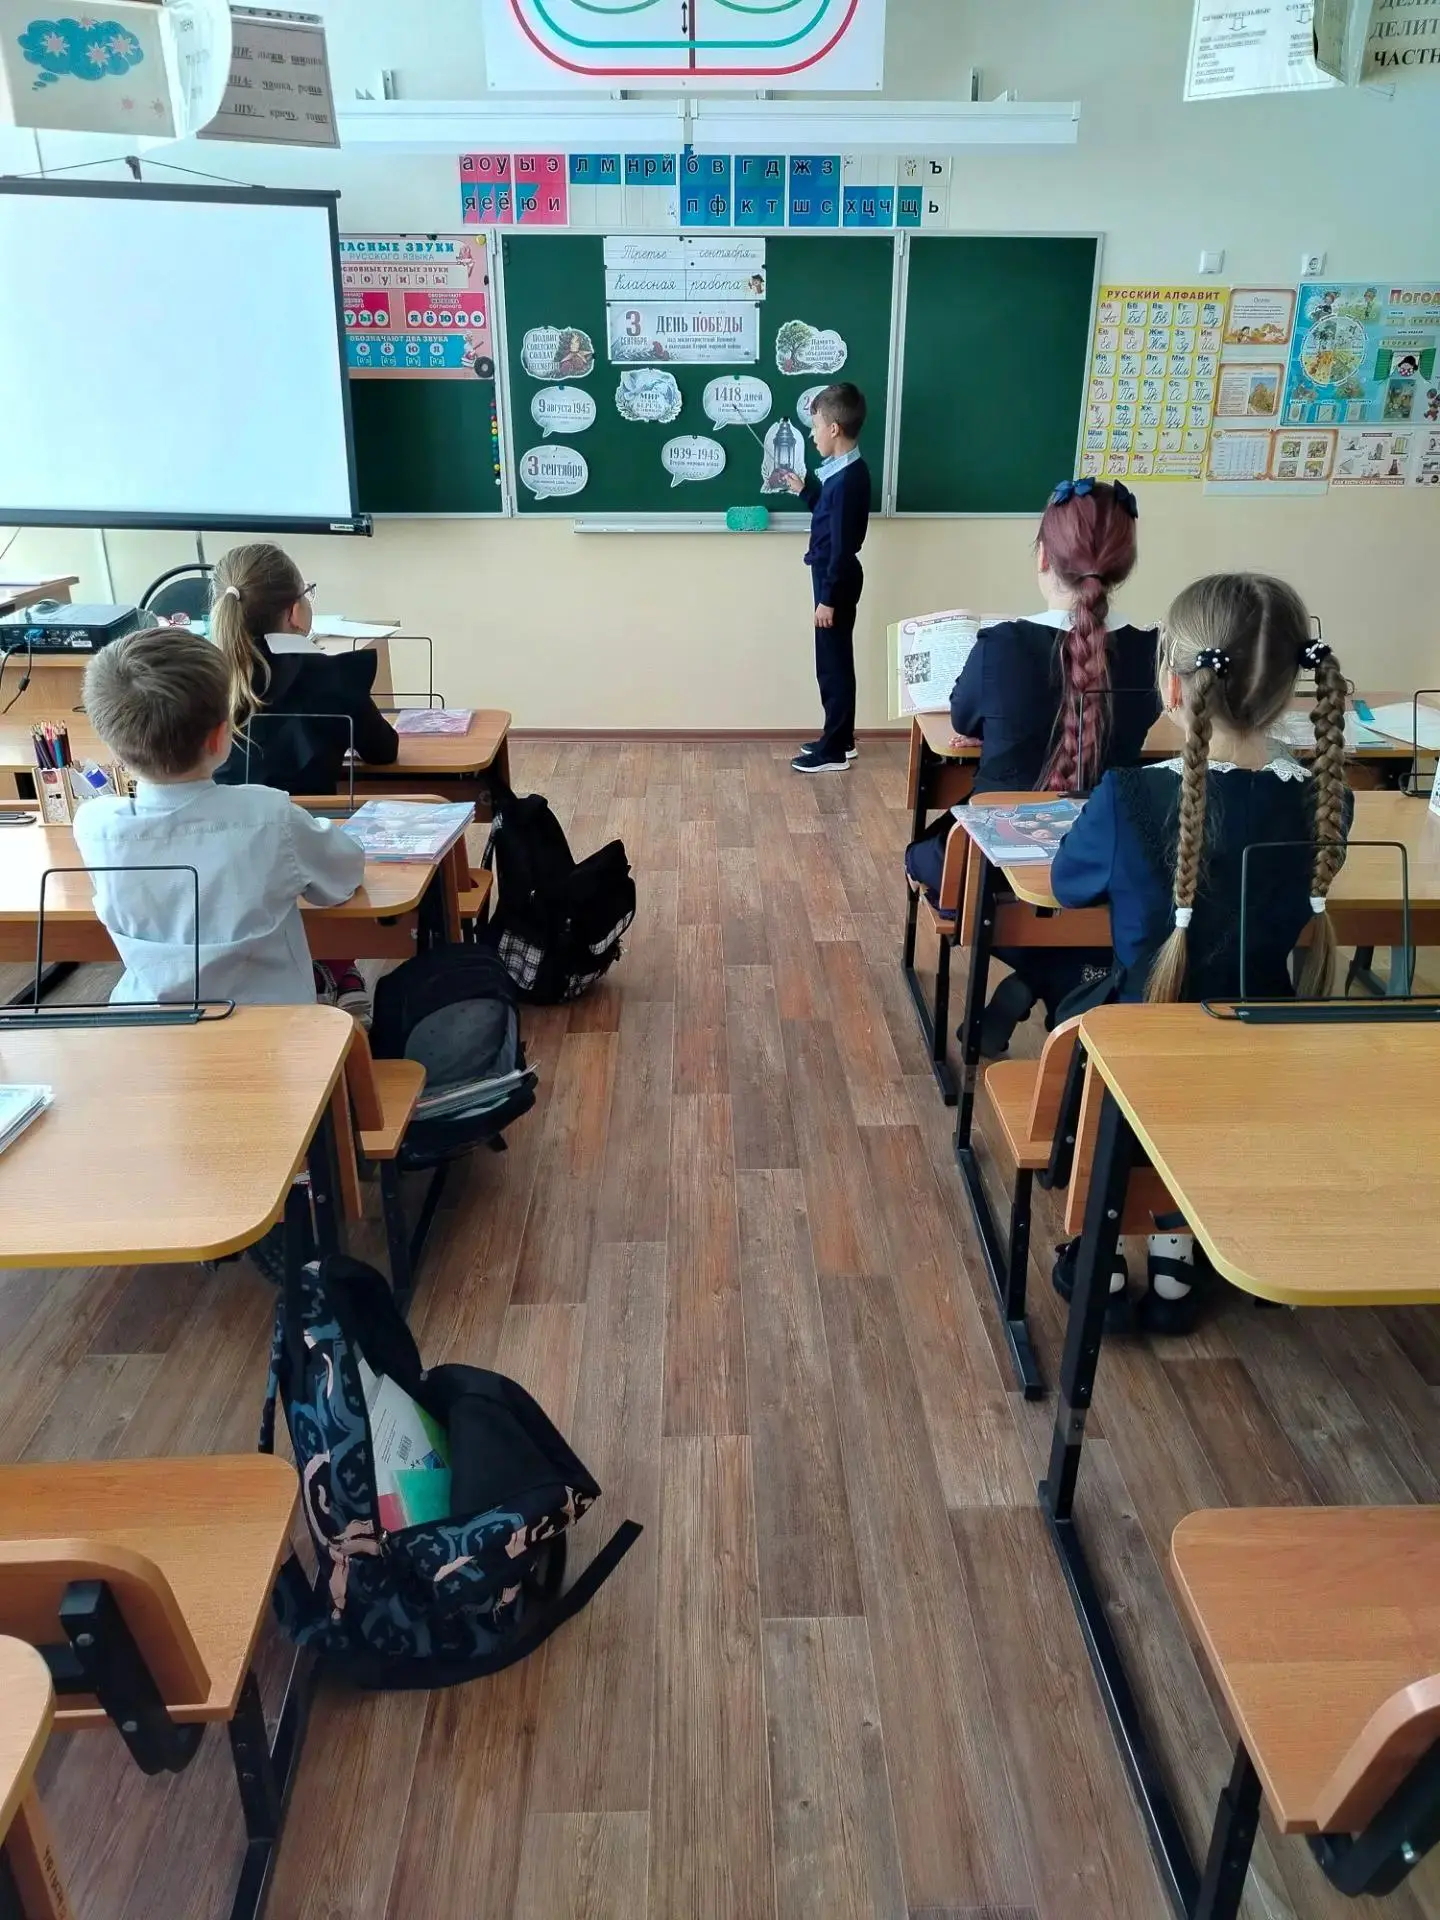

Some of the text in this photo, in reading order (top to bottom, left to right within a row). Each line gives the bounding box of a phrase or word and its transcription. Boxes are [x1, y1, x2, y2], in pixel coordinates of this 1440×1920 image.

[406, 242, 454, 252] ЗВУКИ
[620, 245, 667, 262] Третье
[349, 252, 435, 261] РУССКОГО ЯЗЫКА
[614, 274, 742, 295] Классная работа
[1107, 290, 1220, 300] РУССКИЙ АЛФАВИТ
[625, 310, 641, 337] 3
[656, 316, 743, 335] ДЕНЬ ПОБЕДЫ
[715, 386, 763, 402] 1418 дней
[538, 398, 591, 414] 9 августа 1945
[527, 455, 583, 478] 3 сентября
